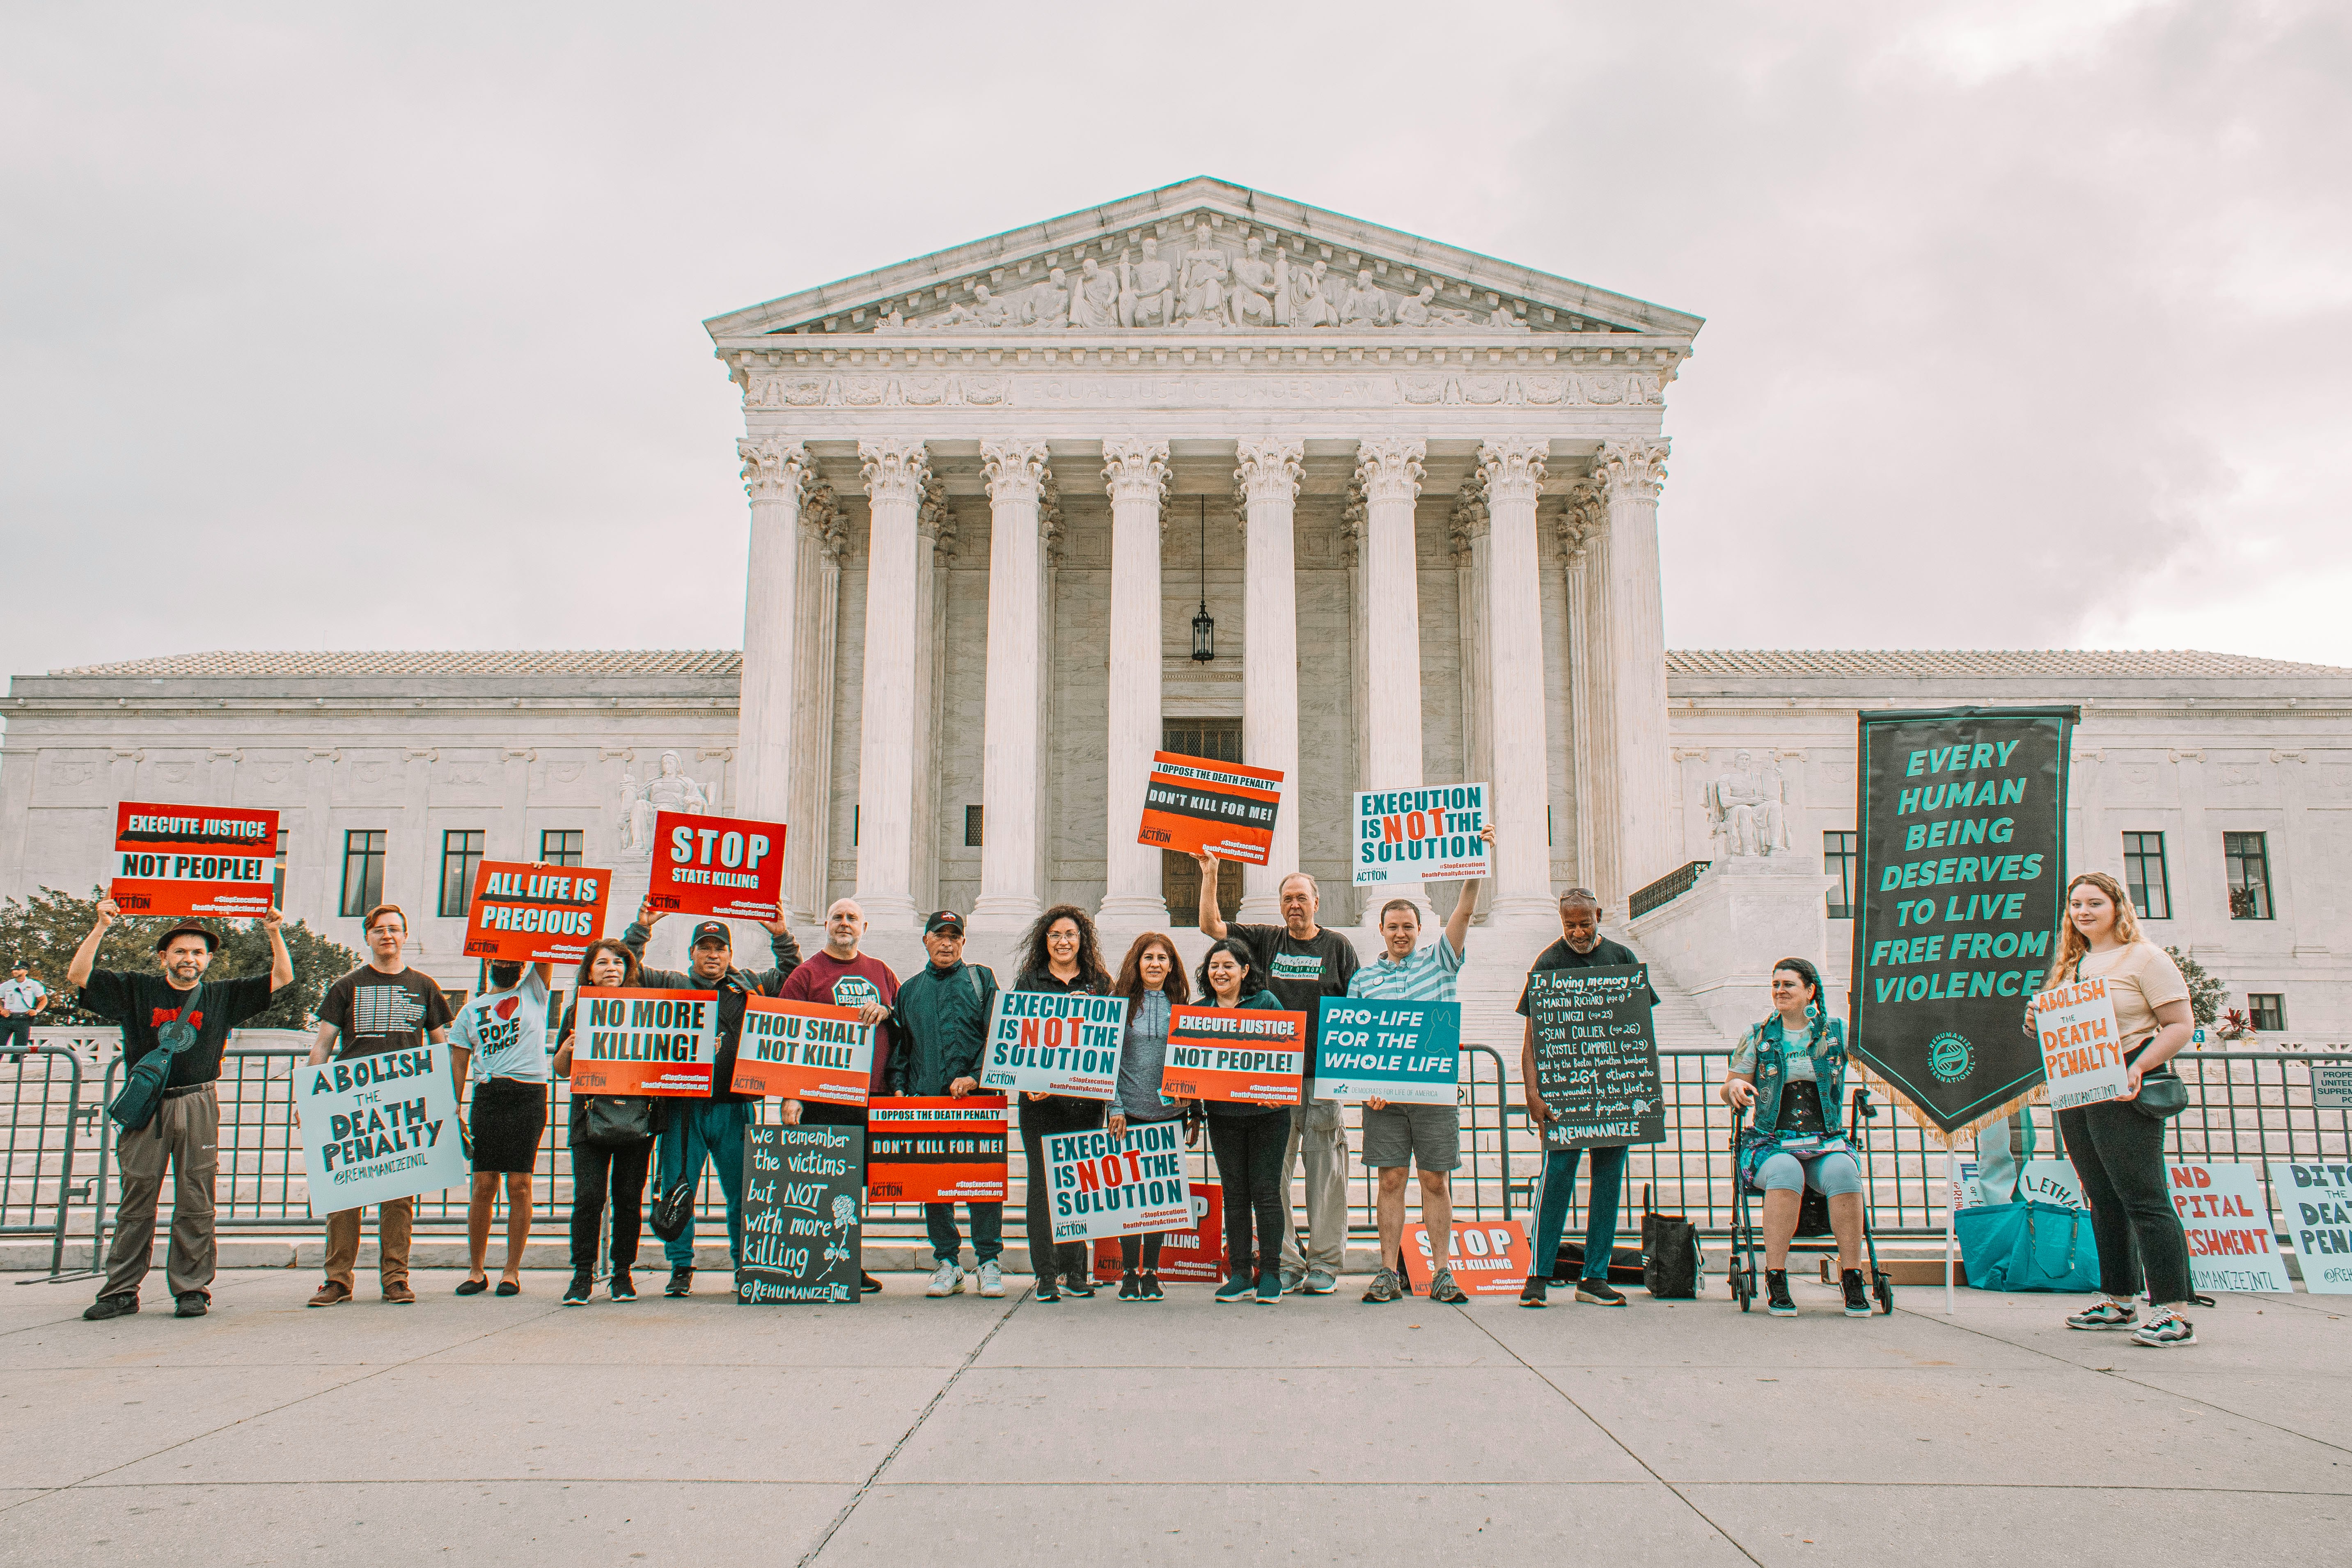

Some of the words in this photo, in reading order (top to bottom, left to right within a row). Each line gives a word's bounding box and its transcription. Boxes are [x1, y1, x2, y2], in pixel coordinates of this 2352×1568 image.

[1033, 381, 1117, 401] EQUAL
[1121, 381, 1221, 400] JUSTICE
[1233, 381, 1318, 399] UNDER
[1326, 381, 1376, 399] LAW
[1906, 740, 2020, 777] EVERY
[1162, 763, 1194, 777] OPPOSE
[1197, 770, 1210, 779] THE
[1213, 772, 1238, 784] DEATH
[1240, 777, 1275, 790] PENALTY
[1149, 789, 1187, 806] DON'T
[1190, 796, 1217, 812] KILL
[1221, 801, 1245, 816] FOR
[1249, 806, 1272, 821] ME!
[1362, 787, 1481, 816] EXECUTION
[1897, 778, 2026, 815] HUMAN
[128, 814, 199, 834] EXECUTE
[202, 819, 266, 838] JUSTICE
[1362, 819, 1381, 839] IS
[1383, 807, 1446, 844] NOT
[1445, 812, 1482, 832] THE
[1905, 817, 2014, 851] BEING
[671, 826, 770, 869] STOP
[1202, 844, 1264, 860] DeathPenaltyAction.org
[1221, 840, 1265, 853] #StopExecutions
[1362, 835, 1483, 863] SOLUTION
[122, 854, 170, 878] NOT
[174, 856, 263, 880] PEOPLE!
[672, 868, 711, 884] STATE
[712, 871, 759, 889] KILLING
[1422, 869, 1485, 878] DeathPenaltyAction.org
[1880, 854, 2043, 892] DESERVES
[485, 872, 523, 896] ALL
[527, 875, 571, 899] LIFE
[574, 878, 598, 901] IS
[480, 905, 592, 935] PRECIOUS
[1896, 899, 1935, 927] TO
[1944, 894, 2026, 922] LIVE
[1869, 934, 1944, 966] FREE
[1949, 931, 2049, 961] FROM
[839, 982, 871, 995] STOP
[1532, 974, 1547, 989] In
[1552, 972, 1583, 995] loving
[1587, 976, 1628, 989] memory
[1630, 970, 1643, 985] of
[1875, 970, 2045, 1003] VIOLENCE
[2038, 978, 2105, 1014] ABOLISH
[838, 995, 876, 1004] EXECUTIONS
[1002, 993, 1122, 1023] EXECUTION
[1543, 998, 1571, 1008] MARTIN
[1574, 995, 1603, 1007] RICHARD
[475, 1005, 492, 1027] I
[590, 999, 626, 1027] NO
[631, 1000, 706, 1029] MORE
[1179, 1015, 1237, 1033] EXECUTE
[1239, 1019, 1295, 1035] JUSTICE
[1326, 1009, 1424, 1027] PRO-LIFE
[1543, 1012, 1554, 1024] LU
[1558, 1011, 1583, 1023] LINGZI
[2060, 1014, 2075, 1023] THE
[478, 1017, 520, 1044] POPE
[746, 1013, 802, 1038] THOU
[805, 1019, 870, 1045] SHALT
[997, 1019, 1019, 1039] IS
[1020, 1017, 1084, 1048] NOT
[1083, 1025, 1119, 1048] THE
[1324, 1030, 1369, 1047] FOR
[1377, 1033, 1418, 1049] THE
[1545, 1028, 1565, 1041] SEAN
[1572, 1026, 1605, 1039] COLLIER
[1623, 1022, 1641, 1035] 26)
[1929, 1032, 1974, 1051] REHUMANIZE
[2043, 1018, 2107, 1052] DEATH
[591, 1032, 699, 1062] KILLING!
[756, 1039, 799, 1063] NOT
[802, 1043, 853, 1068] KILL!
[994, 1042, 1115, 1074] SOLUTION
[1174, 1047, 1213, 1068] NOT
[1217, 1050, 1293, 1072] PEOPLE!
[1546, 1043, 1577, 1058] KRYSTLE
[1581, 1041, 1618, 1055] CAMPBELL
[1632, 1039, 1648, 1051] 29)
[2045, 1041, 2120, 1080] PENALTY
[312, 1049, 433, 1095] ABOLISH
[1325, 1052, 1402, 1071] WHOLE
[1407, 1056, 1453, 1073] LIFE
[1927, 1058, 1976, 1083] INTERNATIONAL
[1050, 1083, 1113, 1094] DeathPenaltyAction.org
[1069, 1076, 1114, 1086] #StopExecutions
[353, 1090, 382, 1106] THE
[330, 1097, 427, 1141] DEATH
[876, 1110, 880, 1120] I
[881, 1110, 915, 1120] OPPOSE
[917, 1110, 933, 1120] THE
[934, 1110, 962, 1120] DEATH
[964, 1110, 1000, 1120] PENALTY
[322, 1119, 444, 1172] PENALTY
[781, 1126, 850, 1148] remember
[872, 1140, 913, 1154] DON'T
[917, 1140, 945, 1154] KILL
[949, 1139, 974, 1154] FOR
[979, 1139, 1003, 1153] ME!
[1051, 1125, 1176, 1163] EXECUTION
[1548, 1121, 1640, 1145] #REHUMANIZE
[753, 1148, 780, 1171] the
[1055, 1165, 1076, 1188] IS
[1076, 1149, 1141, 1193] NOT
[1140, 1153, 1180, 1178] THE
[2167, 1166, 2211, 1189] ND
[747, 1178, 777, 1204] but
[784, 1182, 828, 1208] NOT
[1057, 1178, 1182, 1215] SOLUTION
[2025, 1175, 2081, 1211] LETHA
[2324, 1190, 2347, 1199] THE
[745, 1206, 783, 1234] with
[789, 1217, 832, 1237] more
[743, 1234, 810, 1279] killing
[1415, 1229, 1511, 1257] STOP
